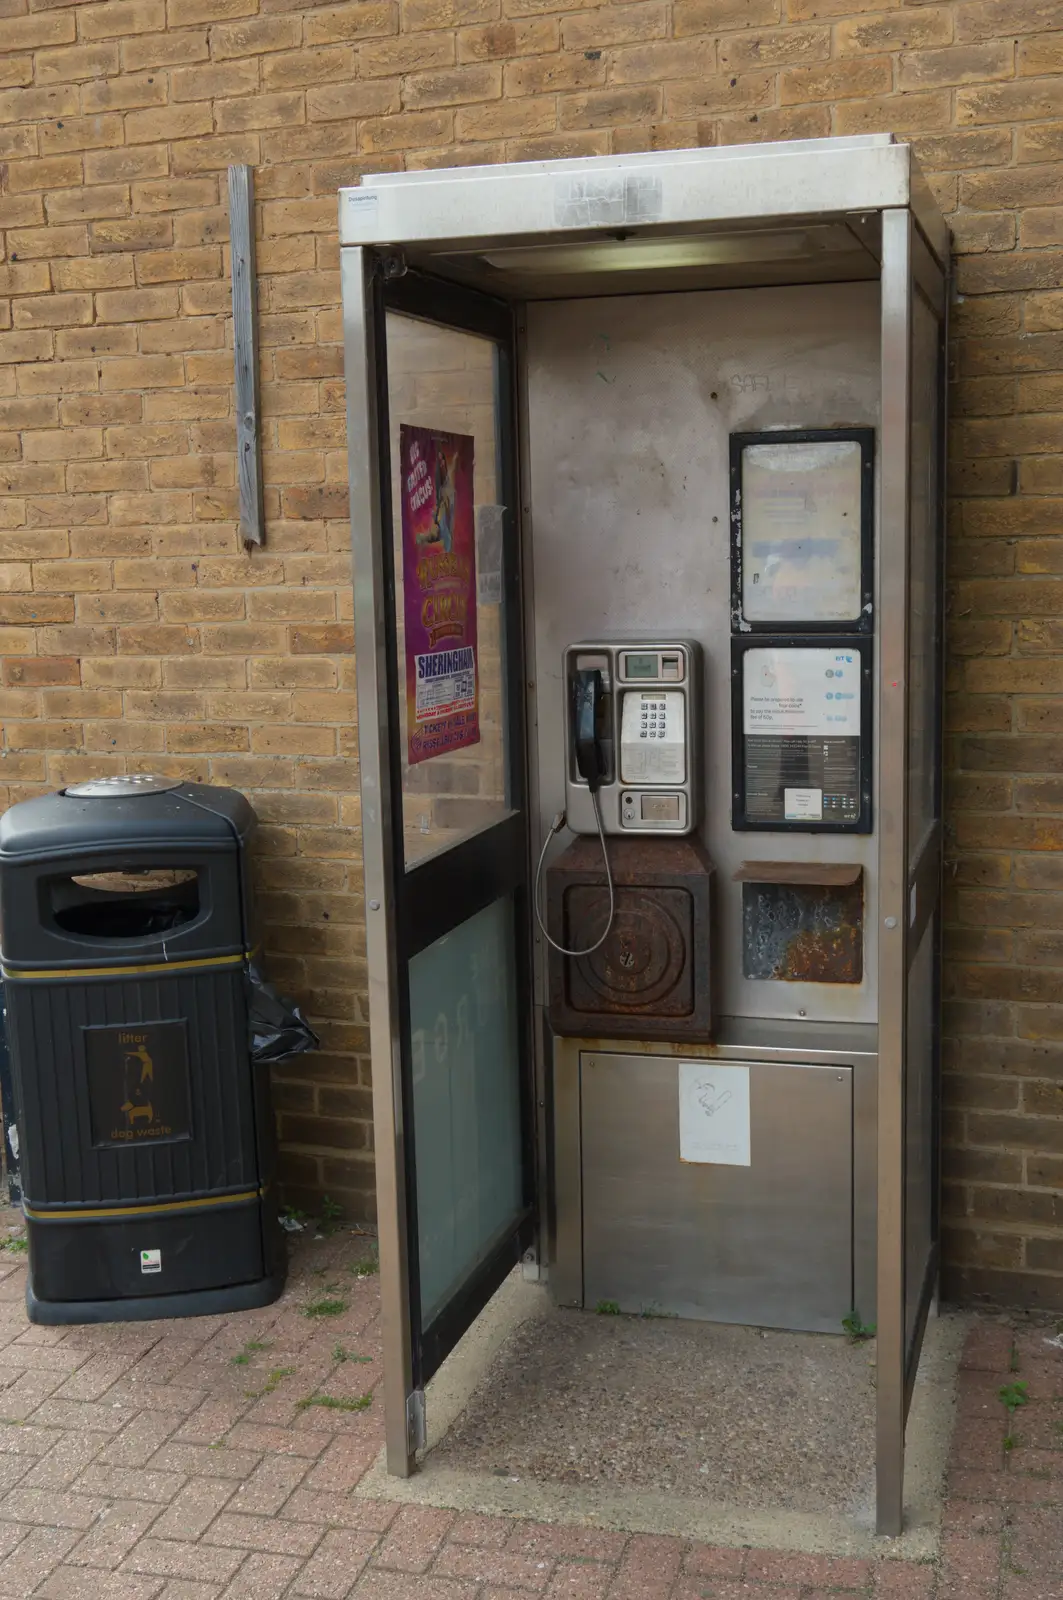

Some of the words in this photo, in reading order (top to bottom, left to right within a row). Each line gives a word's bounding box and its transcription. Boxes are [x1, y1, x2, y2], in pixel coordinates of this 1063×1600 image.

[418, 648, 475, 678] SHERINGHAM
[118, 1033, 148, 1044] litter
[110, 1126, 133, 1140] dog
[136, 1126, 172, 1137] waste
